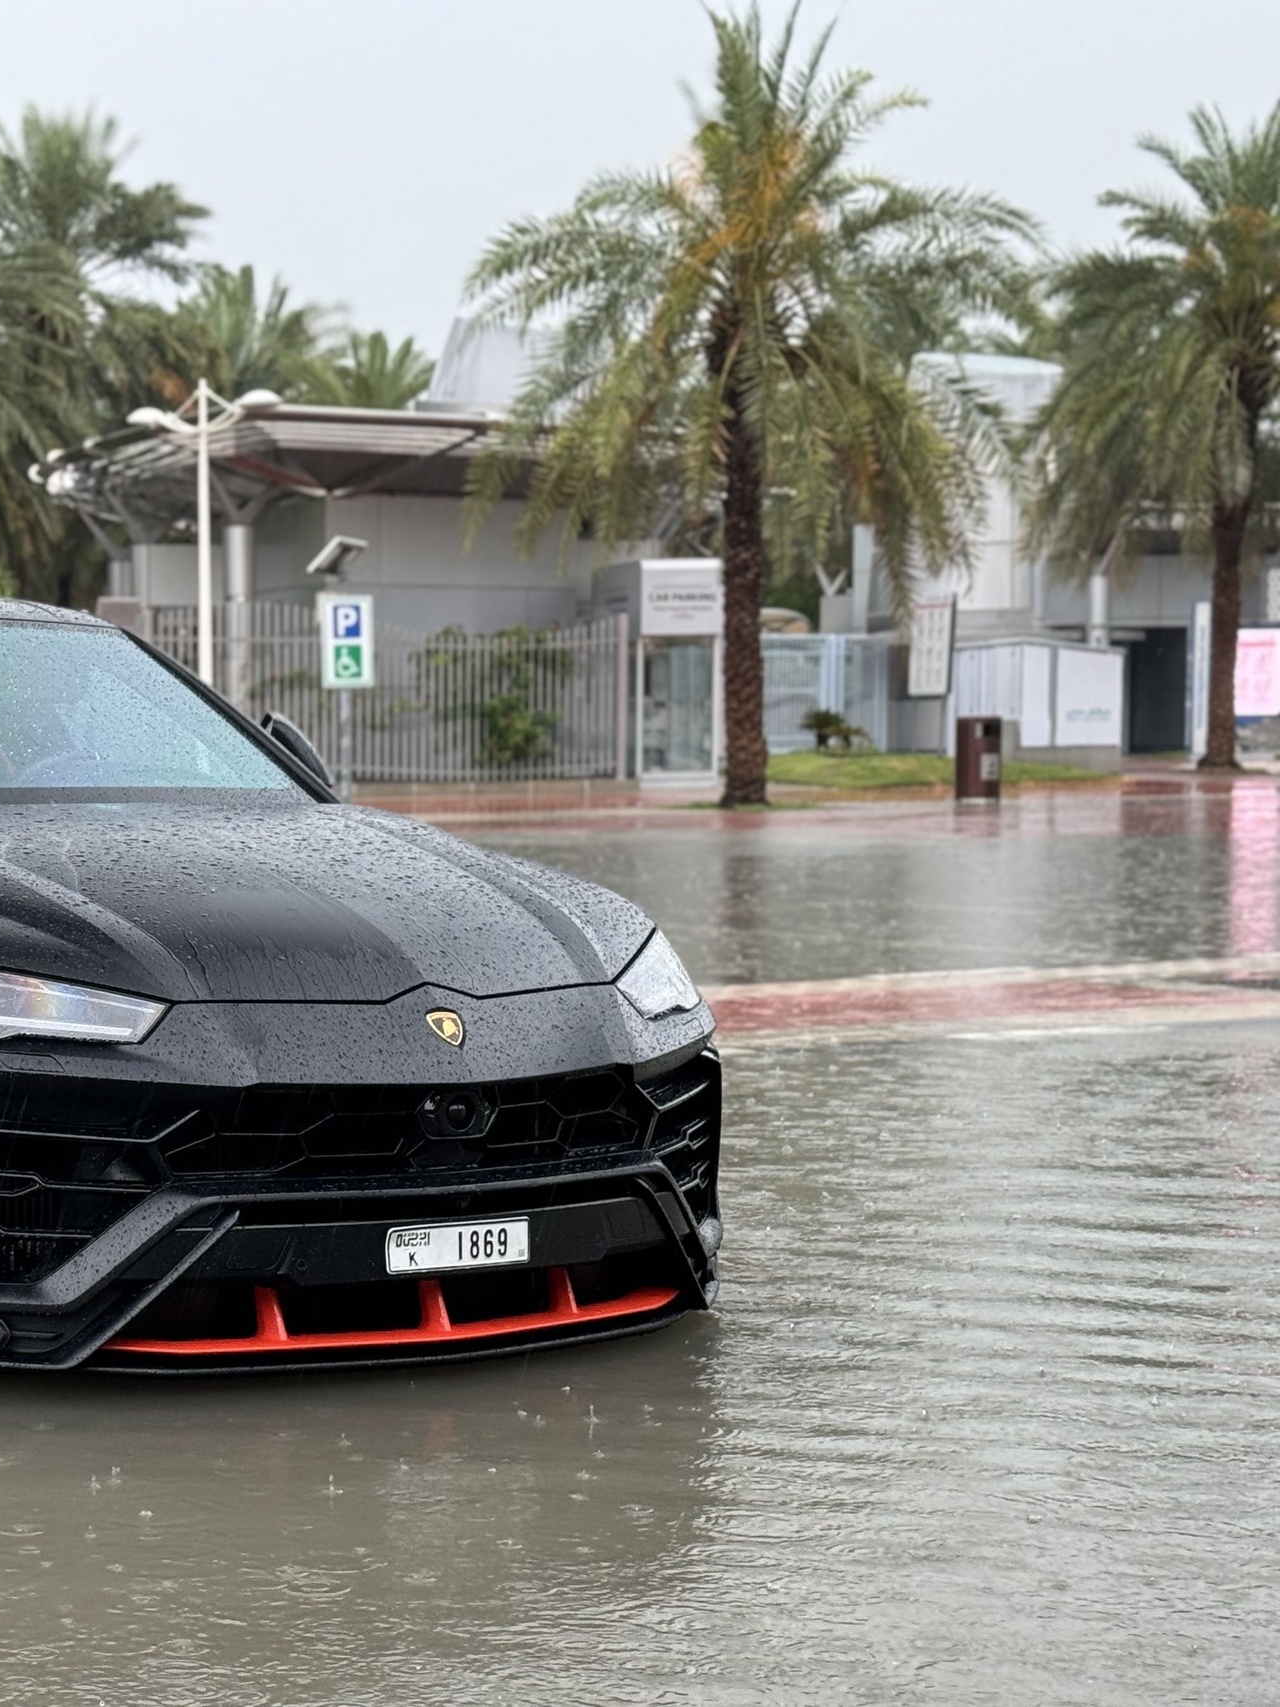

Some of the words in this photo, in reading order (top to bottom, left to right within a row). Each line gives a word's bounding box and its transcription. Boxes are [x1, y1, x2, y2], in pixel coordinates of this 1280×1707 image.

[336, 607, 358, 637] P
[408, 1251, 419, 1267] K
[458, 1227, 508, 1261] 1869
